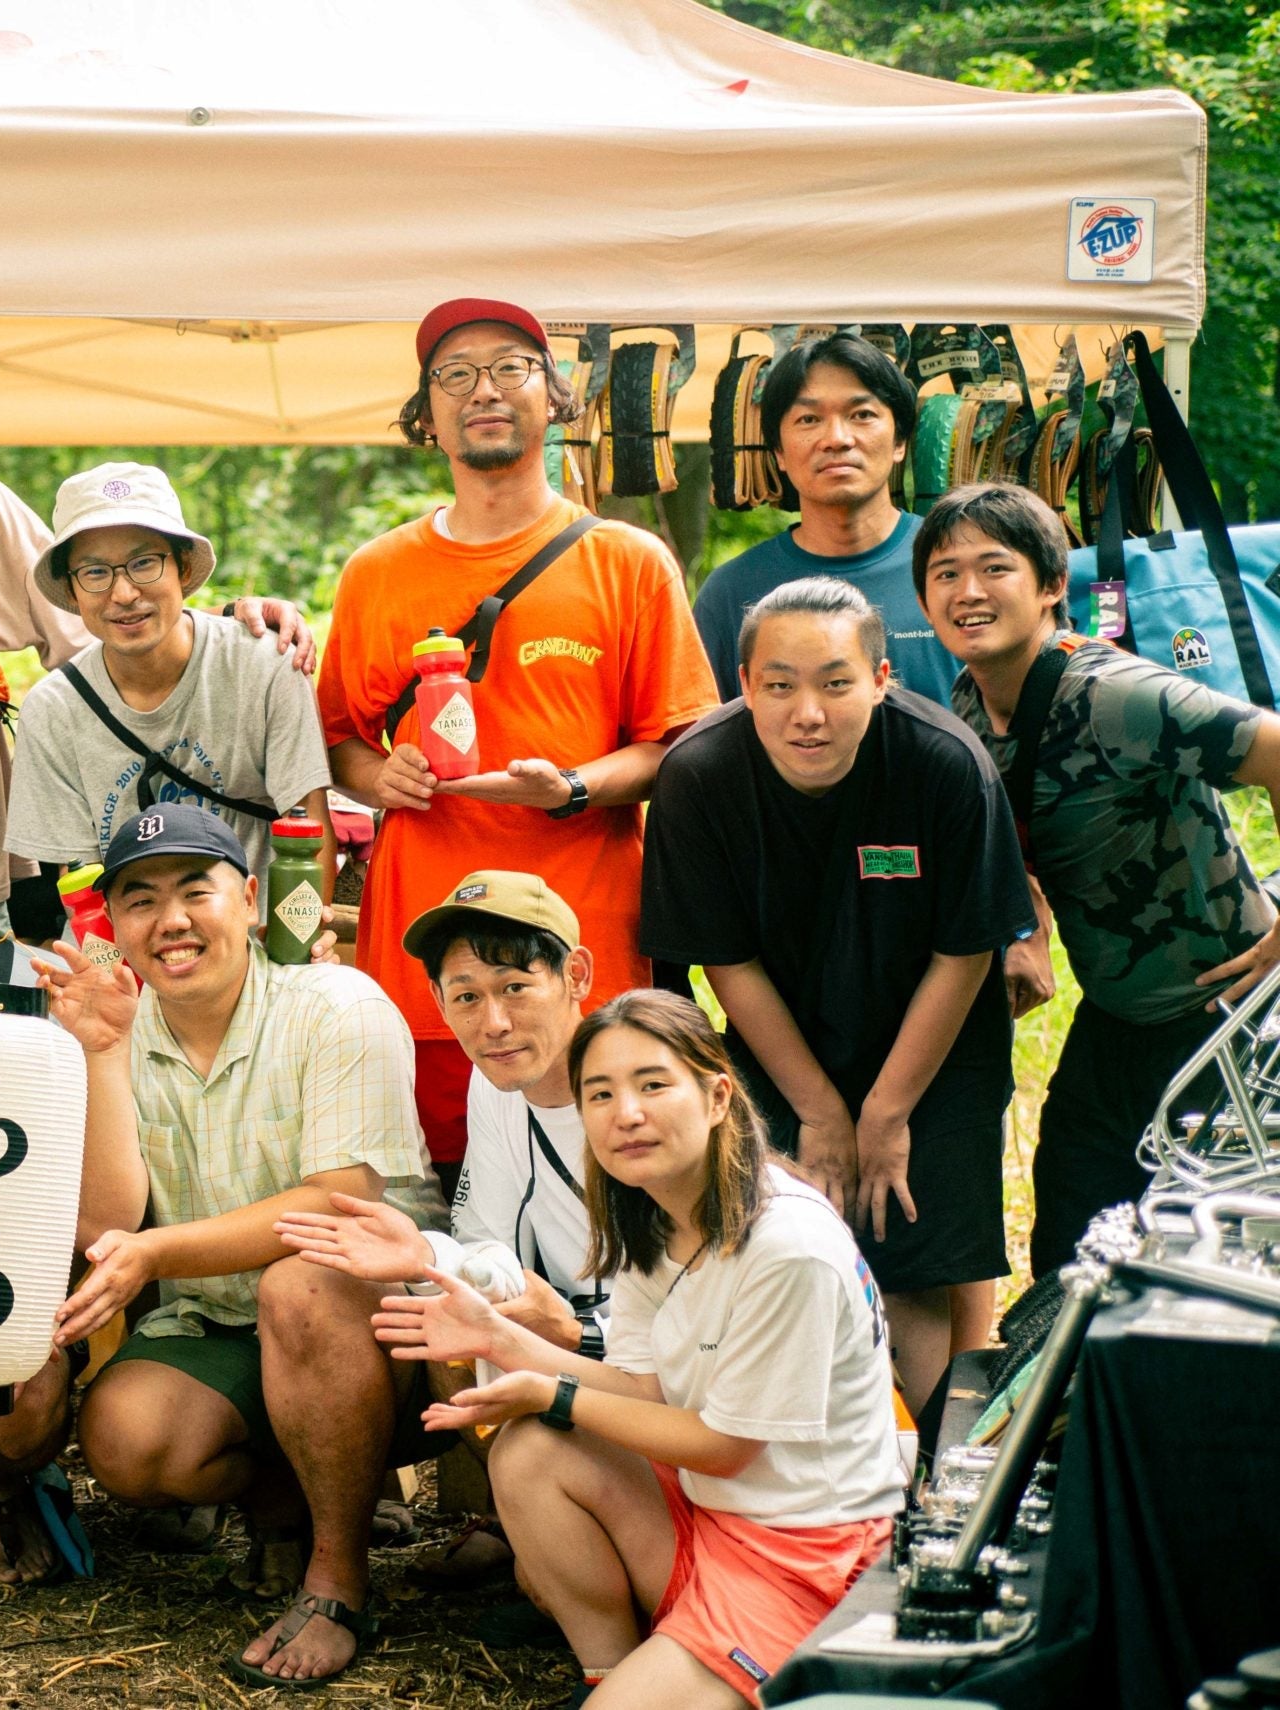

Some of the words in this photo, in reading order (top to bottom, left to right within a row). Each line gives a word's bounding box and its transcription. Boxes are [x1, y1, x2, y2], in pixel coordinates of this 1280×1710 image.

[1098, 591, 1120, 637] RAL
[519, 636, 604, 666] GRAVELHUNT
[1175, 648, 1209, 664] RAL
[193, 742, 214, 768] 2016
[116, 761, 141, 789] 2010
